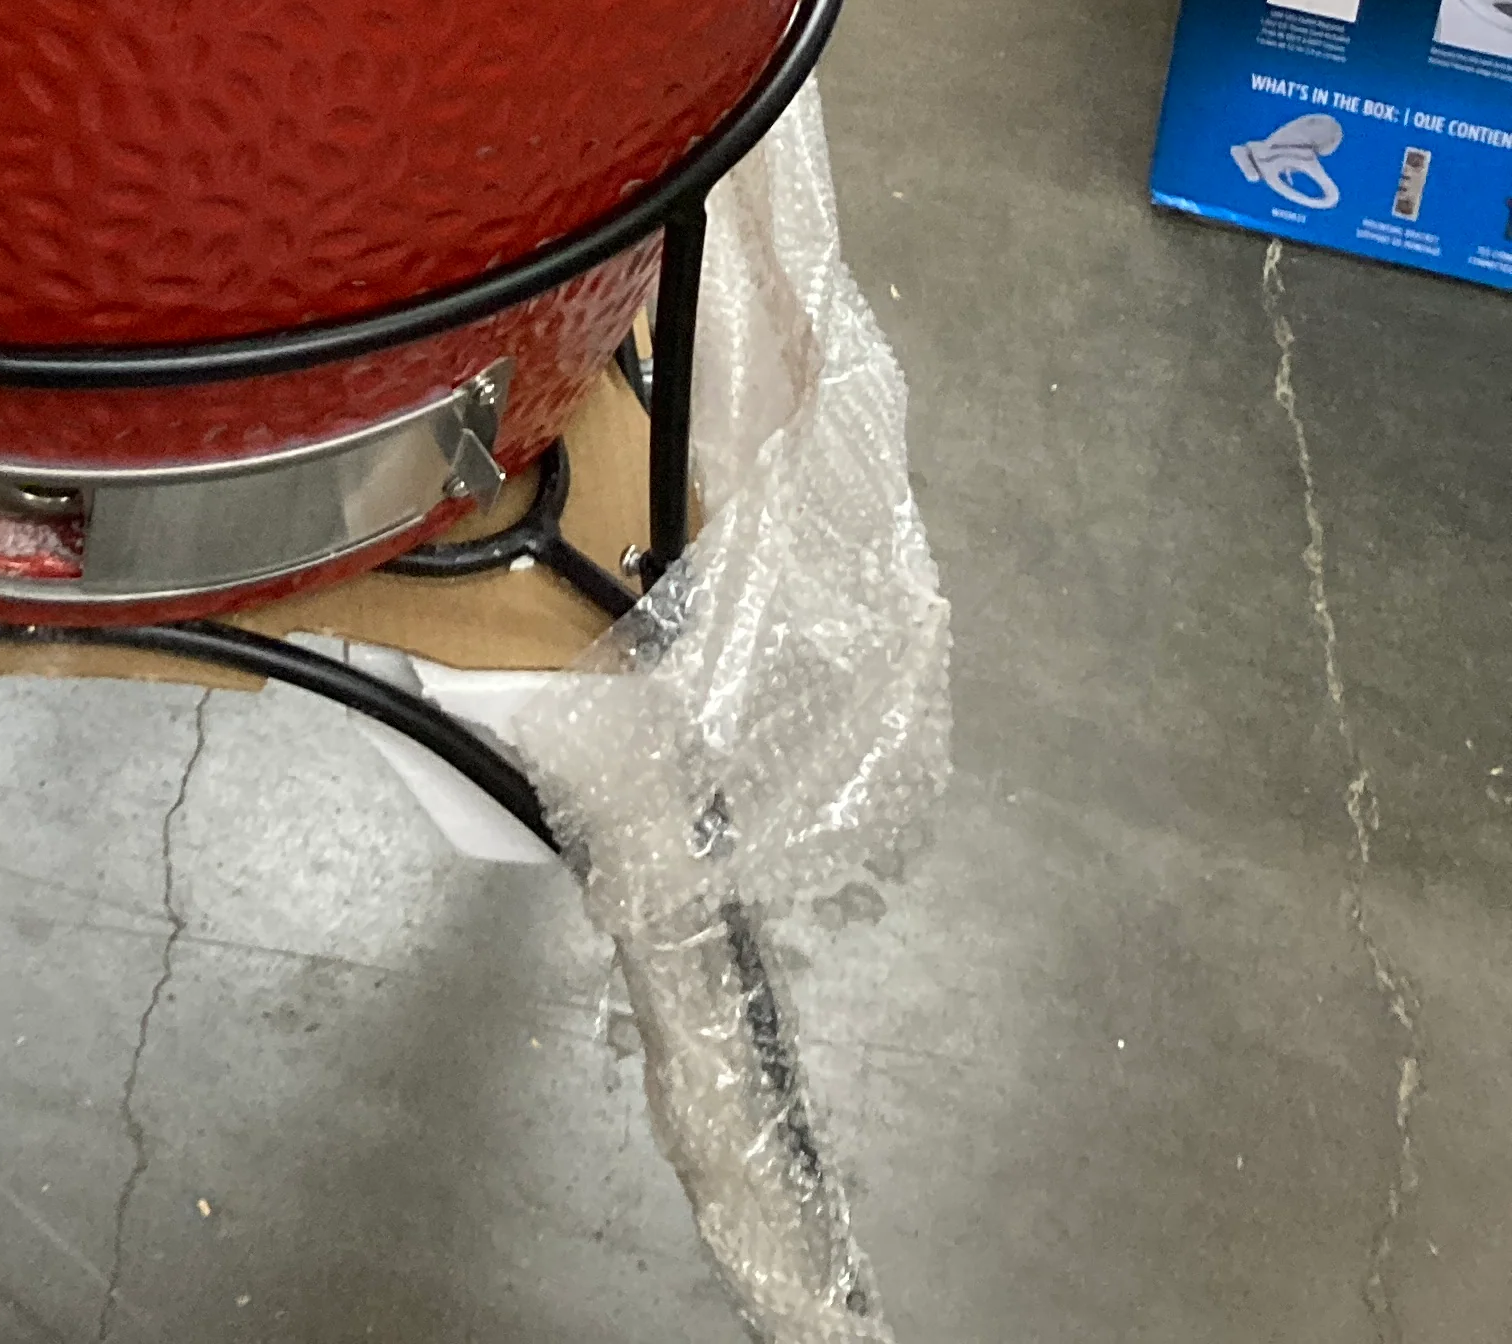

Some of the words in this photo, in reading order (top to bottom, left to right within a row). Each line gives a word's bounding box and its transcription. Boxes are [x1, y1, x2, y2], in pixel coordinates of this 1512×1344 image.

[1251, 72, 1309, 101] WHAT'S
[1312, 87, 1329, 106] IN
[1333, 92, 1361, 114] THE
[1362, 99, 1400, 124] BOX:
